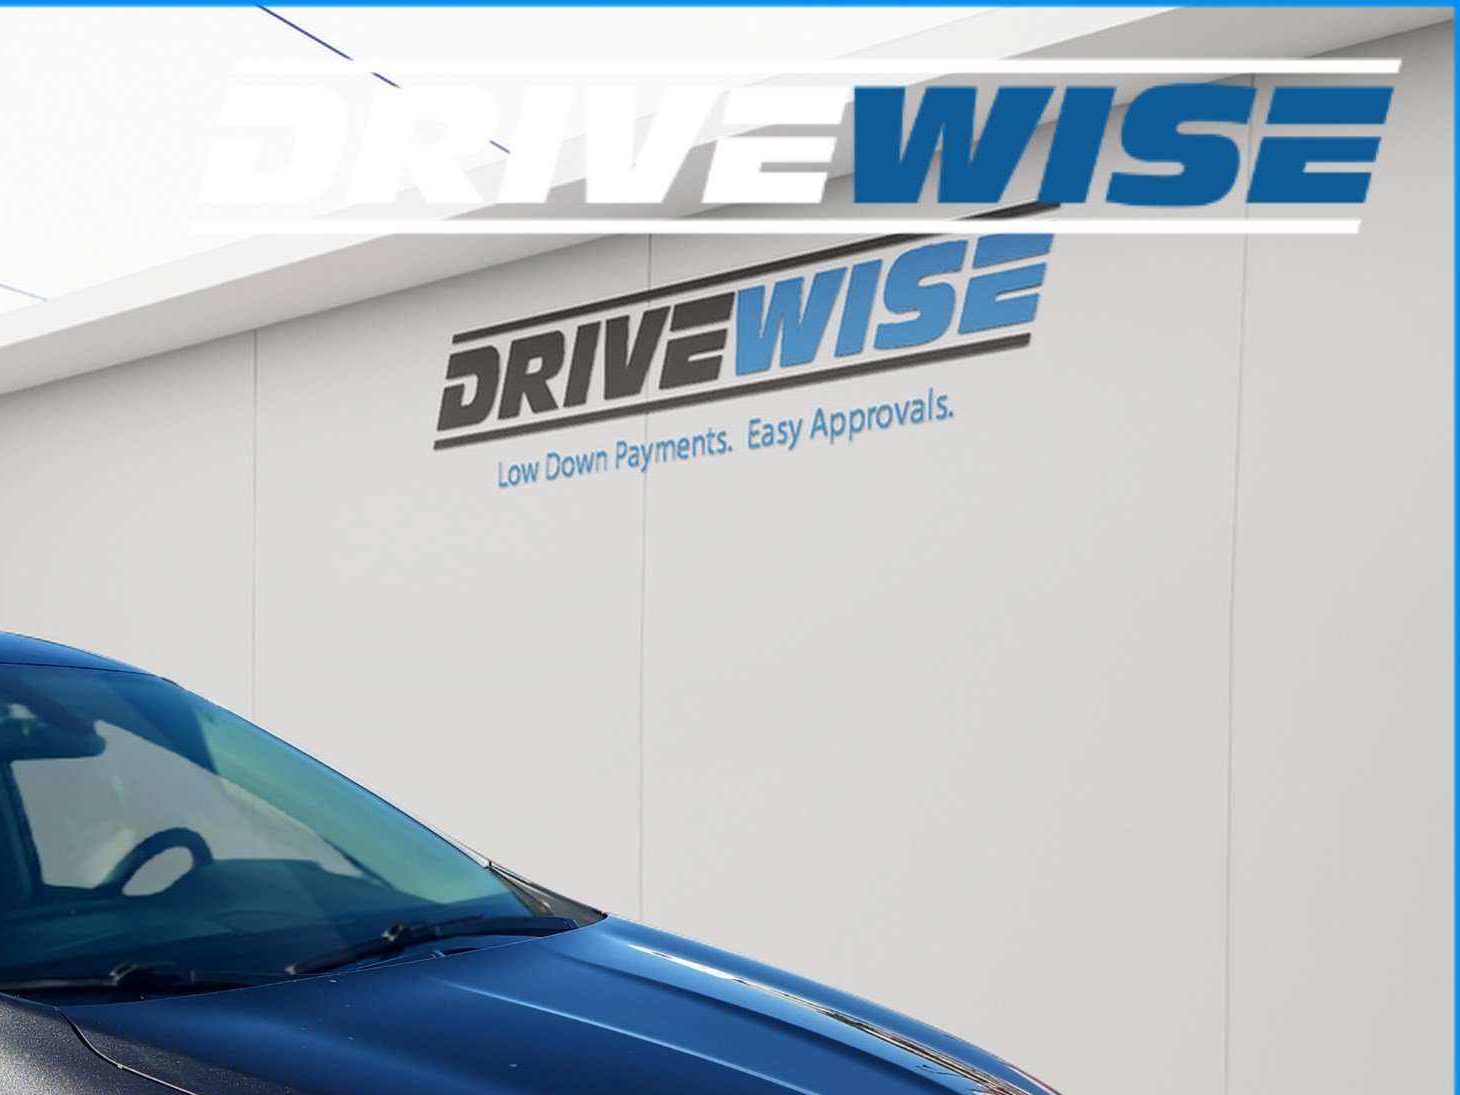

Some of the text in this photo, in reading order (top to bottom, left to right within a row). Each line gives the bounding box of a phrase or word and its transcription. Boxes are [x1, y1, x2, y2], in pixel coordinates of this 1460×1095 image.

[436, 233, 1055, 431] DRIVEWISE
[497, 386, 955, 488] Low Down Payments. Easy Approvals.
